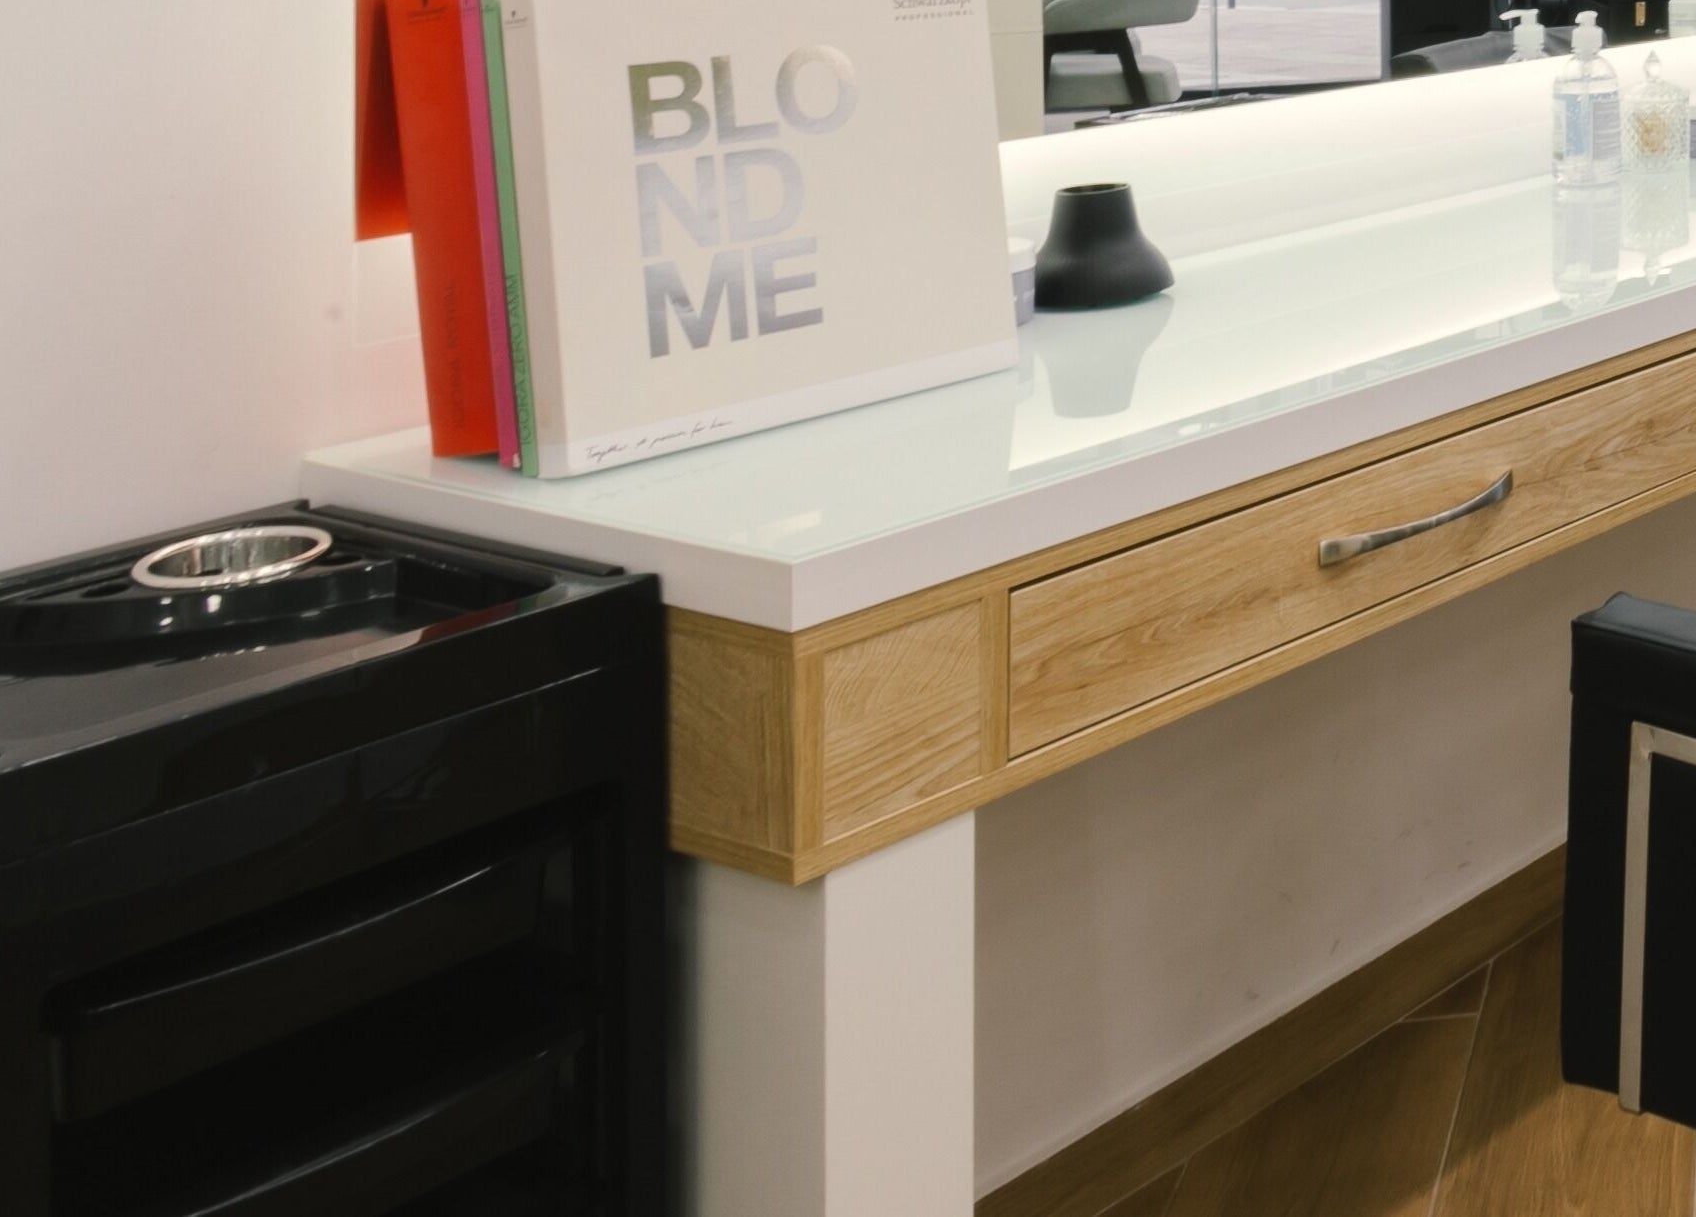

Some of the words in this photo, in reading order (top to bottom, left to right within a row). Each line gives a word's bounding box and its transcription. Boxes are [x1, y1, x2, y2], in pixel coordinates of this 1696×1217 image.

[627, 43, 858, 157] BLO
[634, 145, 806, 258] ND
[644, 237, 824, 360] ME
